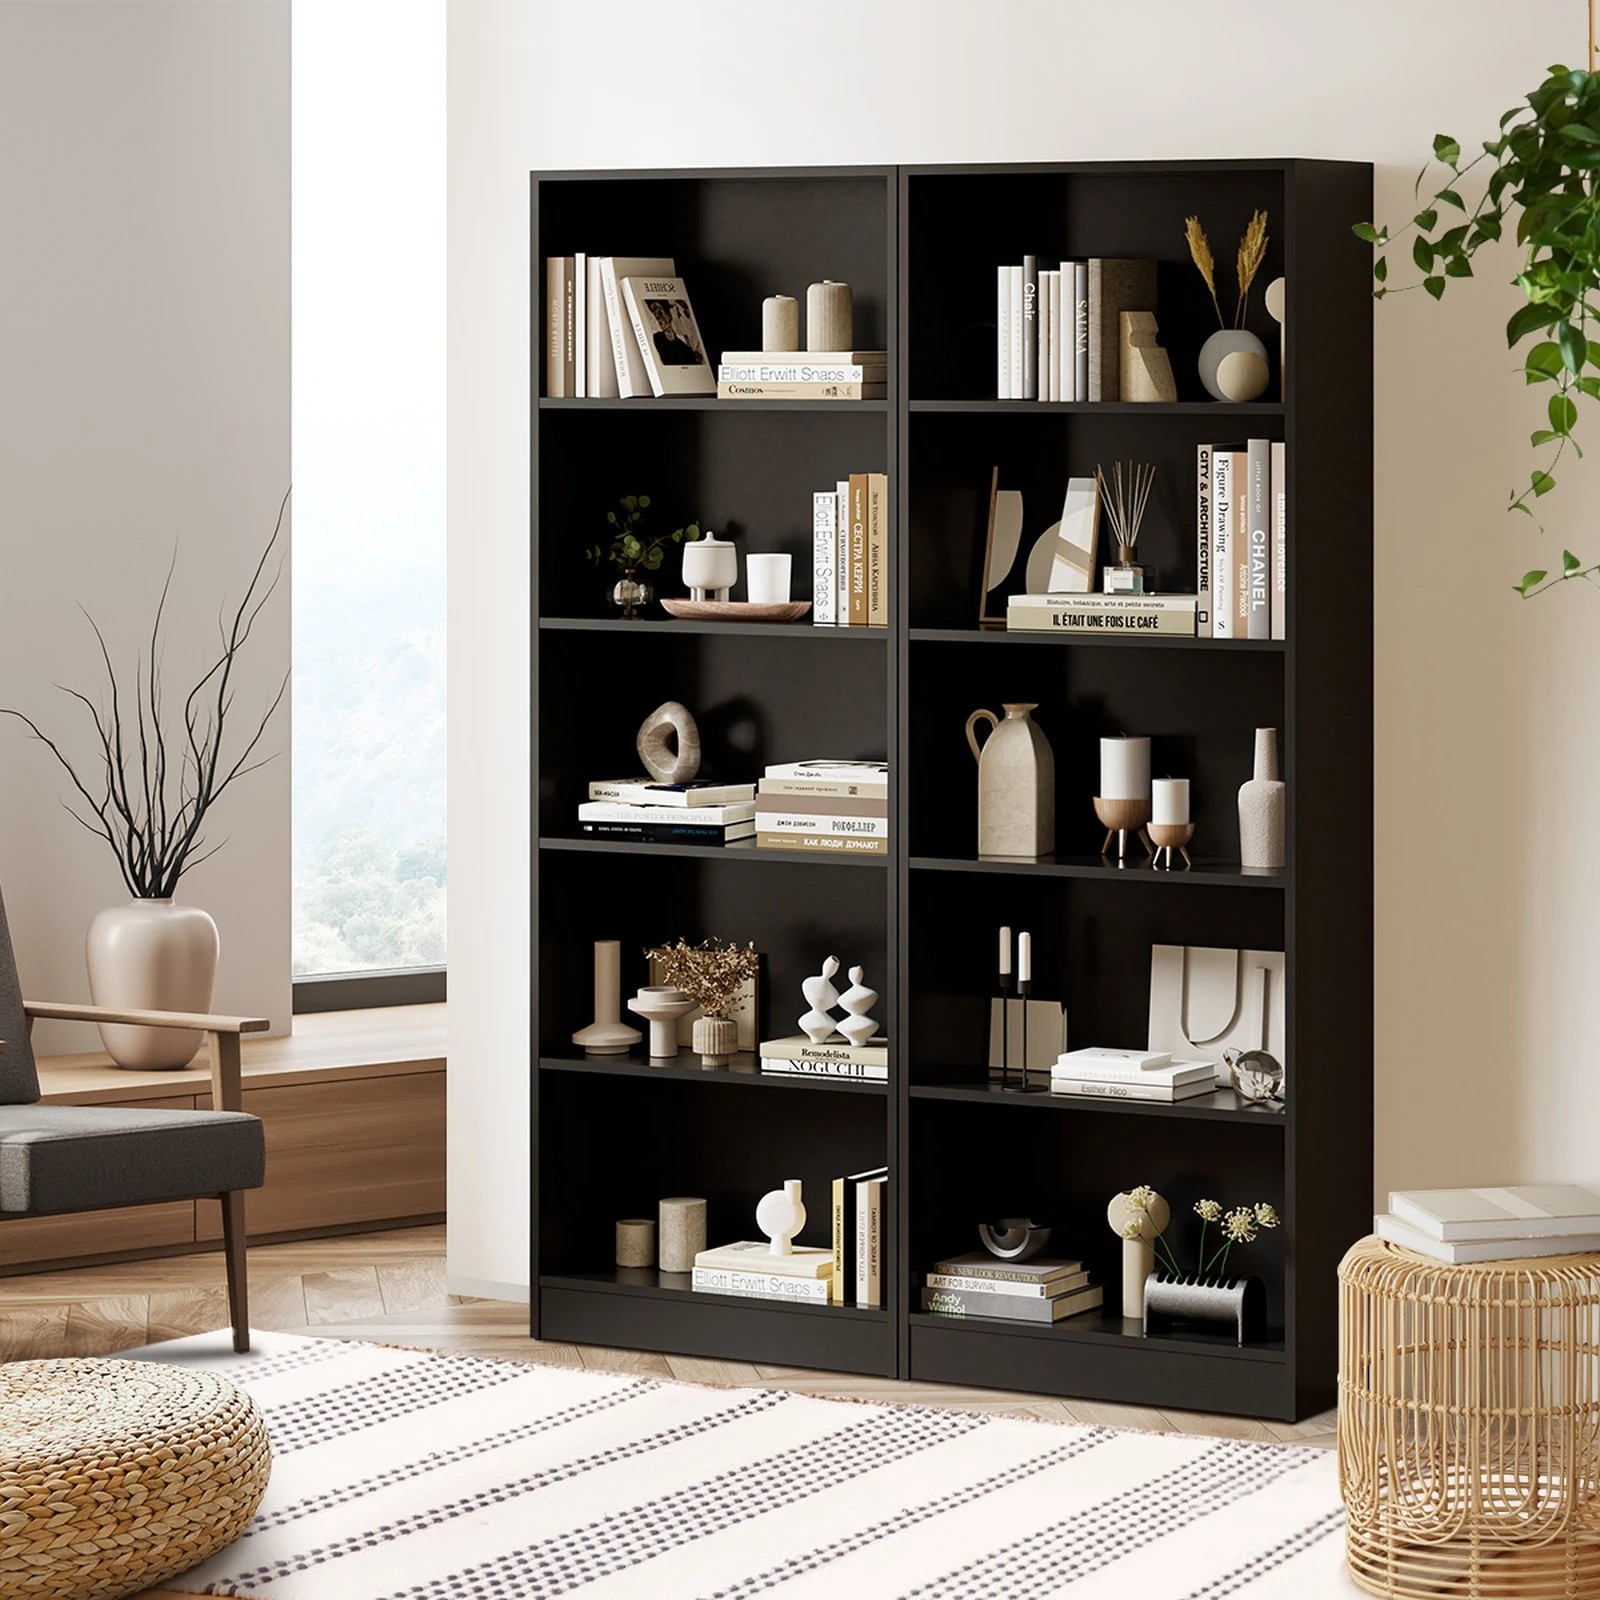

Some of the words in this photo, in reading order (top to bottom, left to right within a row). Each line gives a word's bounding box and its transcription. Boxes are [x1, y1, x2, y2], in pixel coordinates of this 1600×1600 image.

[1024, 282, 1036, 321] Chair
[722, 366, 756, 381] Elliott
[760, 367, 796, 381] Erwitt
[1200, 450, 1208, 479] CITY
[1200, 482, 1208, 491] &
[1216, 459, 1229, 498] Figure
[816, 496, 832, 526] Elliott
[1216, 502, 1228, 553] Drawing
[816, 530, 832, 564] Erwitt
[853, 522, 864, 562] СЕСТРА
[1200, 496, 1208, 592] ARCHITECTURE
[853, 562, 864, 594] КЕРРИ
[1252, 530, 1266, 611] CHANEL
[1053, 614, 1061, 626] IL
[1062, 612, 1085, 626] ÉTAIT
[1087, 616, 1103, 627] UNE
[1105, 616, 1124, 628] FOIS
[1126, 617, 1135, 628] LE
[1137, 614, 1158, 629] CAFÉ
[832, 820, 876, 832] РОКФЕЛЛЕР
[804, 838, 819, 846] КАК
[820, 839, 843, 848] ЛЮДИ
[845, 840, 879, 850] ДУМАЮТ
[802, 1048, 850, 1059] Remodelista
[789, 1060, 865, 1076] NOGUCHI
[1081, 1084, 1106, 1094] Esther
[1110, 1086, 1128, 1096] Rico
[695, 1270, 727, 1287] Elliott
[732, 1274, 766, 1291] Erwitt
[976, 1268, 993, 1278] LOOK
[995, 1270, 1039, 1282] REVOLUTION
[933, 1277, 946, 1286] ART
[949, 1278, 962, 1288] FOR
[965, 1280, 996, 1291] SURVIVAL
[933, 1292, 961, 1306] Andy
[928, 1302, 965, 1314] Warhol
